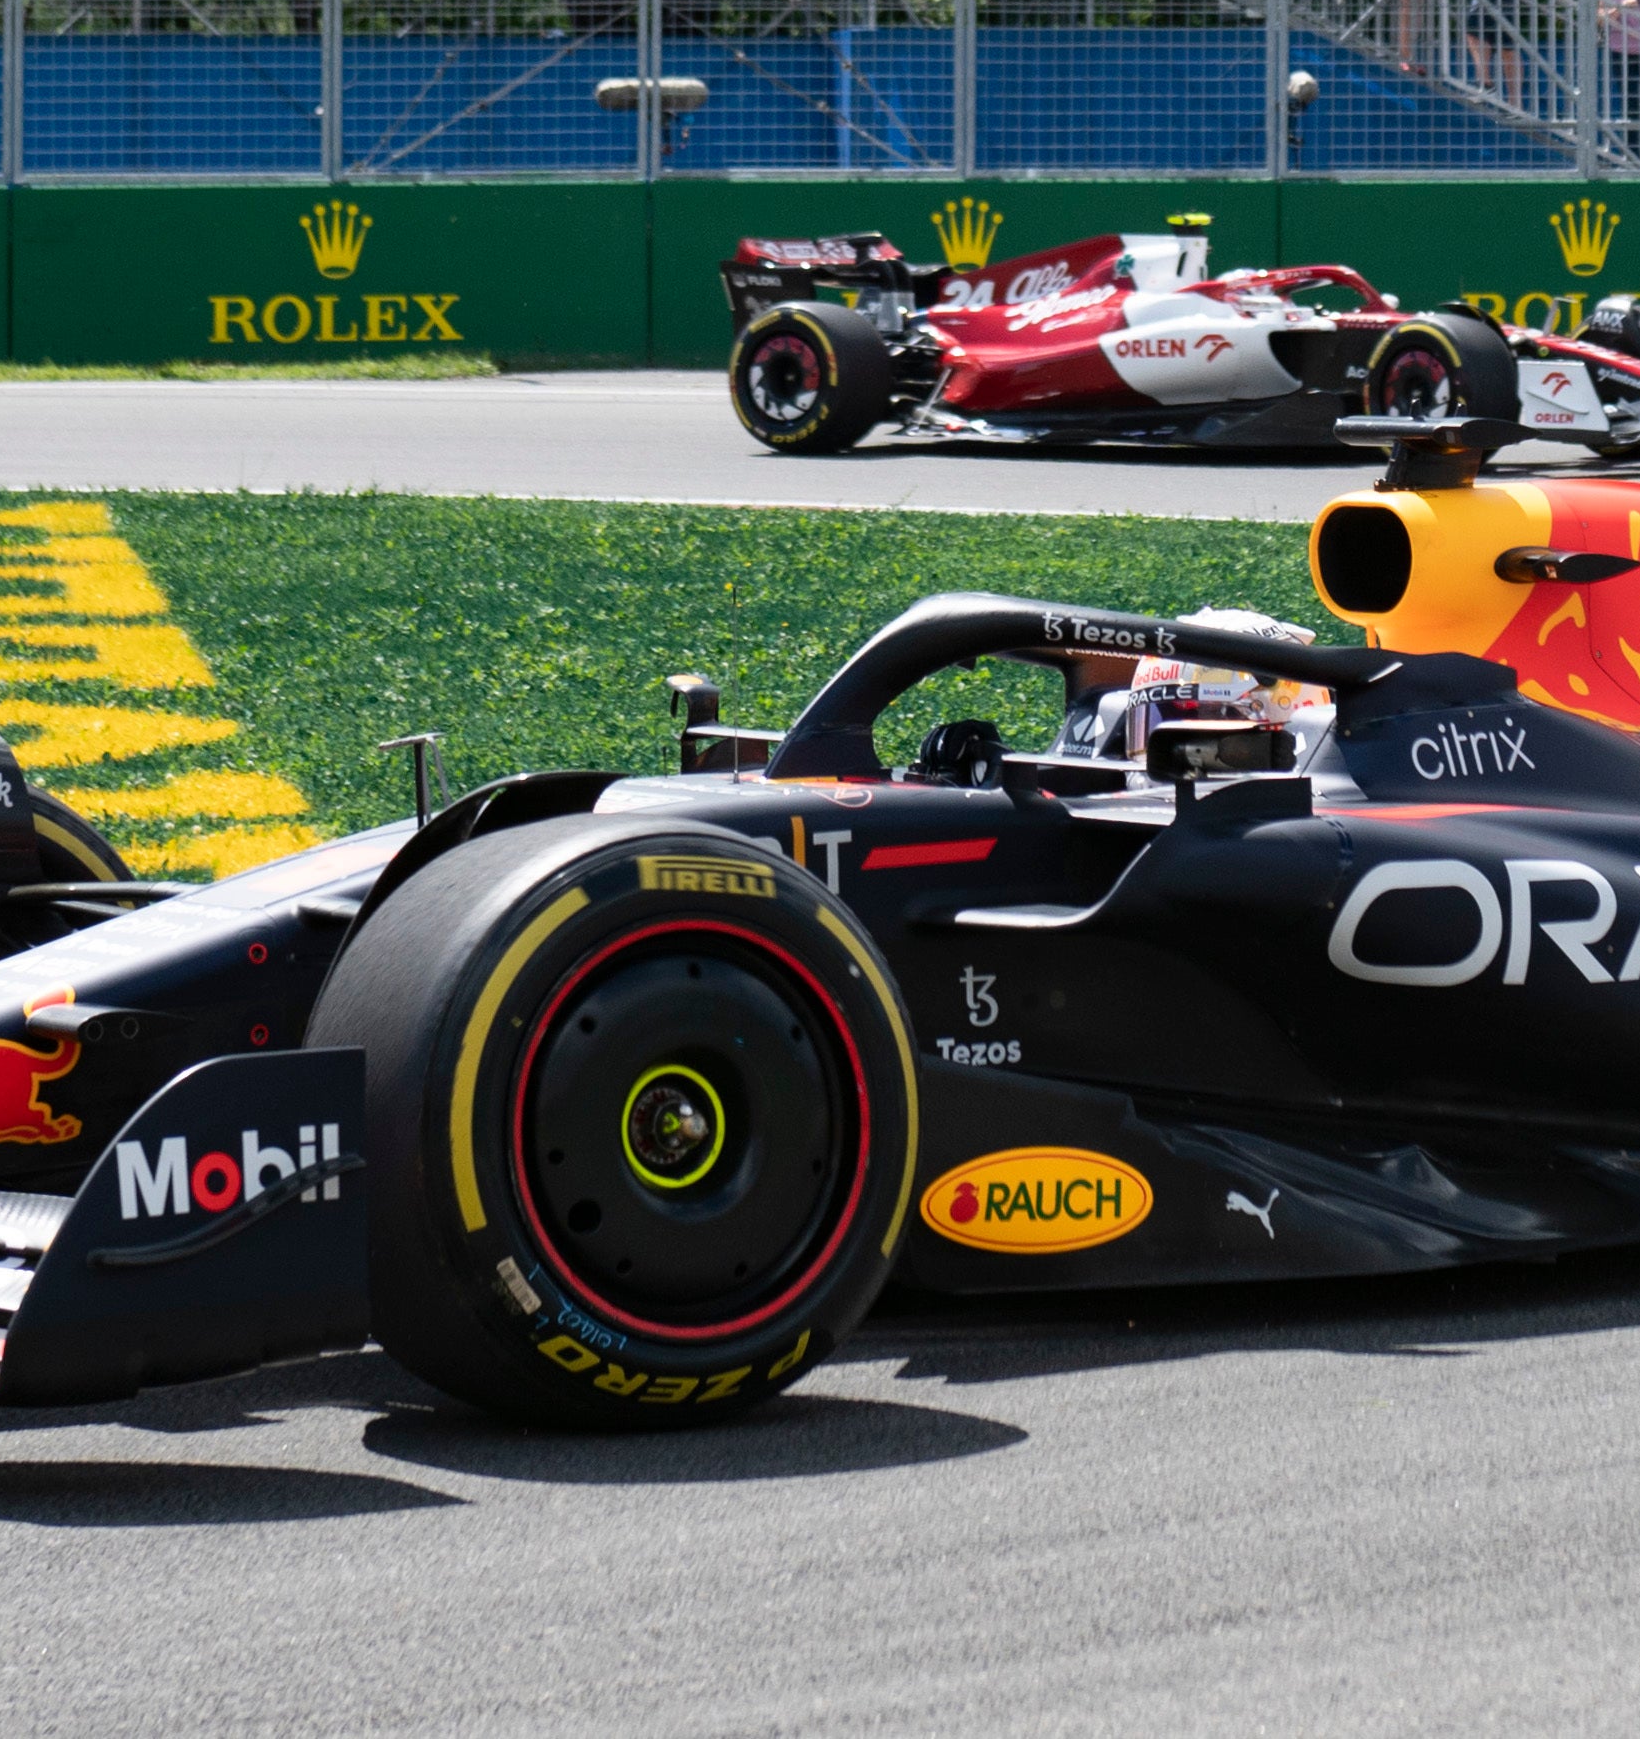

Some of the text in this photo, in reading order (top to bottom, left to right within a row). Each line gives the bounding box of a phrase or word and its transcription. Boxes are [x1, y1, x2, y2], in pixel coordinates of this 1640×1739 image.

[943, 279, 995, 312] 24
[208, 293, 464, 345] ROLEX
[1115, 339, 1186, 358] ORLEN
[1534, 413, 1575, 424] ORLEN
[1071, 617, 1147, 649] Tezos
[1411, 716, 1536, 782] citrix
[636, 855, 777, 899] PIRELLI
[935, 1037, 1022, 1066] Tezos
[116, 1122, 341, 1222] Mobil
[984, 1178, 1122, 1223] RAUCH
[536, 1327, 811, 1405] P ZERO
